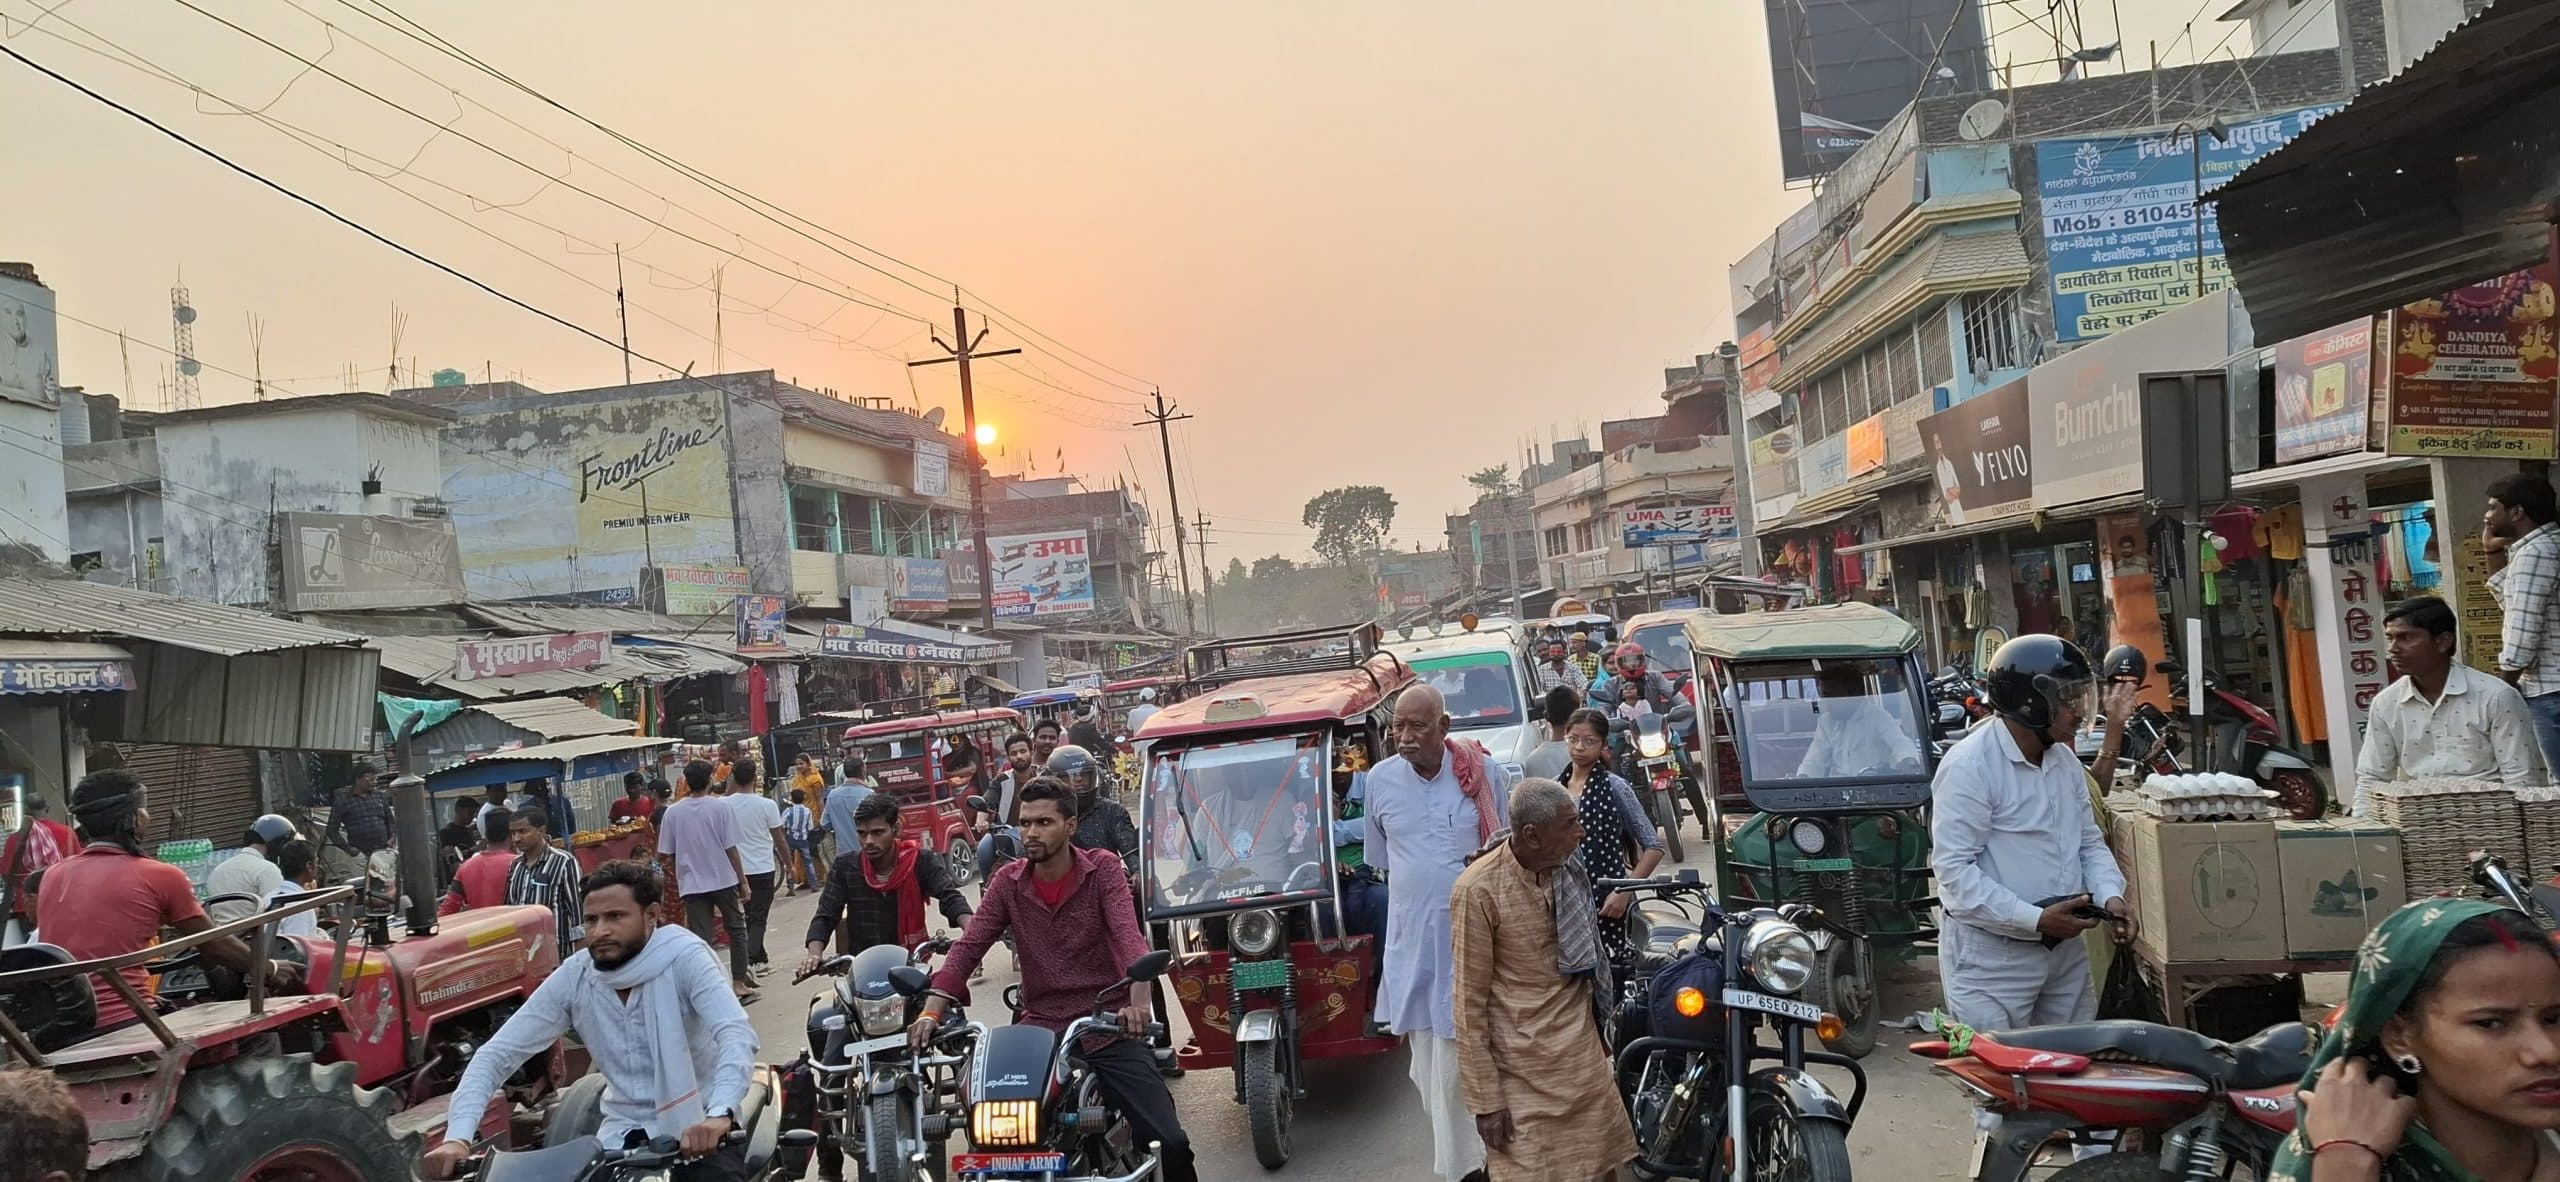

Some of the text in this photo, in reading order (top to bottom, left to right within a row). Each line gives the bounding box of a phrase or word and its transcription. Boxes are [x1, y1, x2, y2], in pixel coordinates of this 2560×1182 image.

[2052, 214, 2102, 234] Mob
[2058, 269, 2123, 290] डायबिटीज
[2128, 263, 2173, 282] रिवर्सल
[2089, 287, 2158, 308] लिकोरिया
[2079, 314, 2109, 331] चेहरे
[2447, 331, 2507, 343] DANDIYA
[2437, 343, 2517, 356] CELEBRATION
[2055, 383, 2141, 448] Bumchu
[578, 426, 722, 504] Frontline
[603, 515, 635, 529] PREMIU
[664, 512, 691, 526] WEAR
[1626, 510, 1666, 521] UMA
[1028, 536, 1086, 559] उमा
[605, 587, 632, 600] 24593
[1401, 594, 1421, 604] ACC
[474, 637, 551, 677] मुस्कान
[12, 662, 98, 689] मेडिकल
[420, 979, 476, 1005] Mahindra
[1737, 994, 1754, 1005] UP
[1793, 1004, 1820, 1019] 2121
[2243, 1096, 2281, 1112] TVS
[991, 1155, 1061, 1170] INDIAN ARMY
